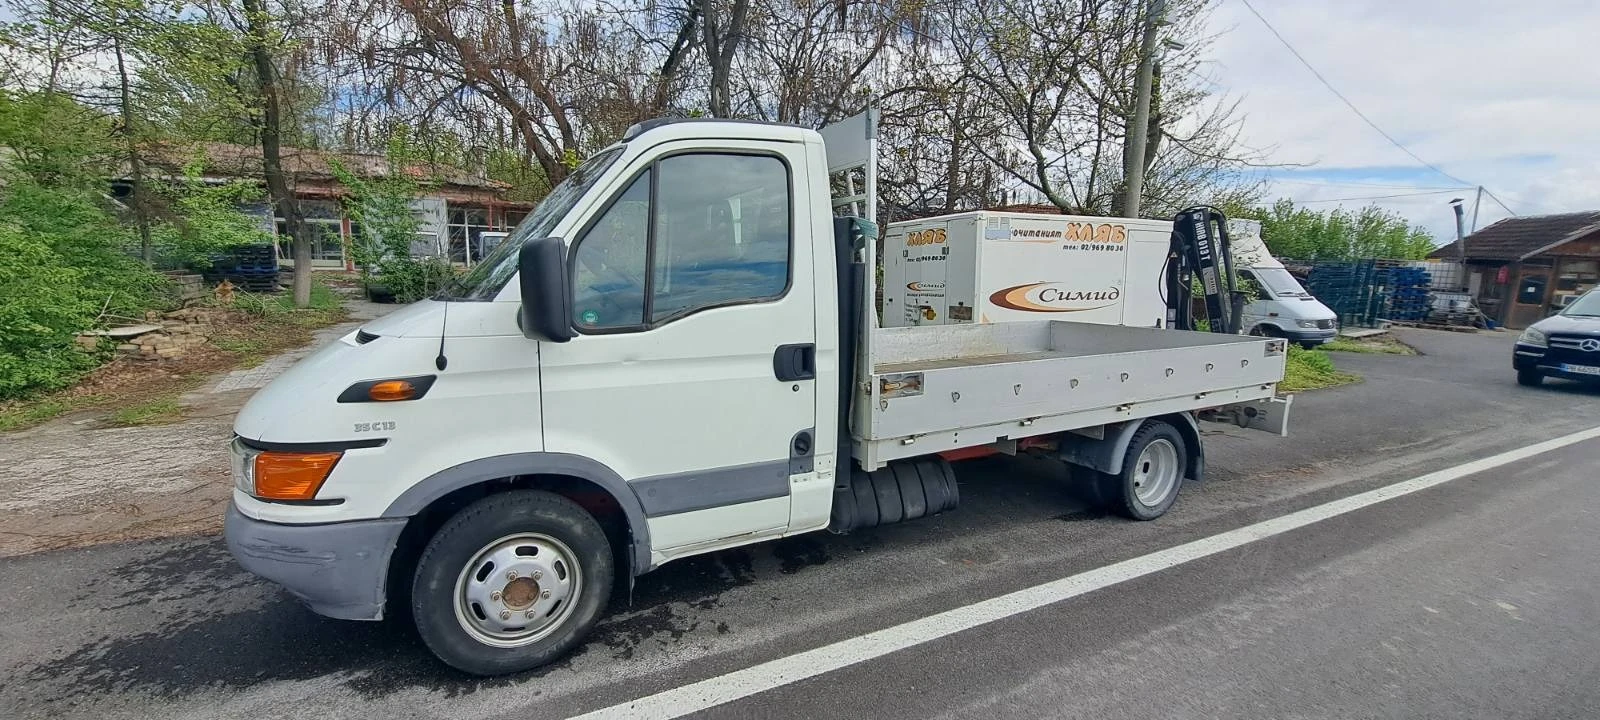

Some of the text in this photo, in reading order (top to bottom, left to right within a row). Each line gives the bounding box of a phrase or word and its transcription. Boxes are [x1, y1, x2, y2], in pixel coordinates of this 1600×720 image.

[906, 228, 947, 246] ХЛЯБ
[1011, 222, 1126, 243] очитаният ХЛЯБ
[1195, 221, 1207, 241] HIAB
[1038, 286, 1120, 303] Симид
